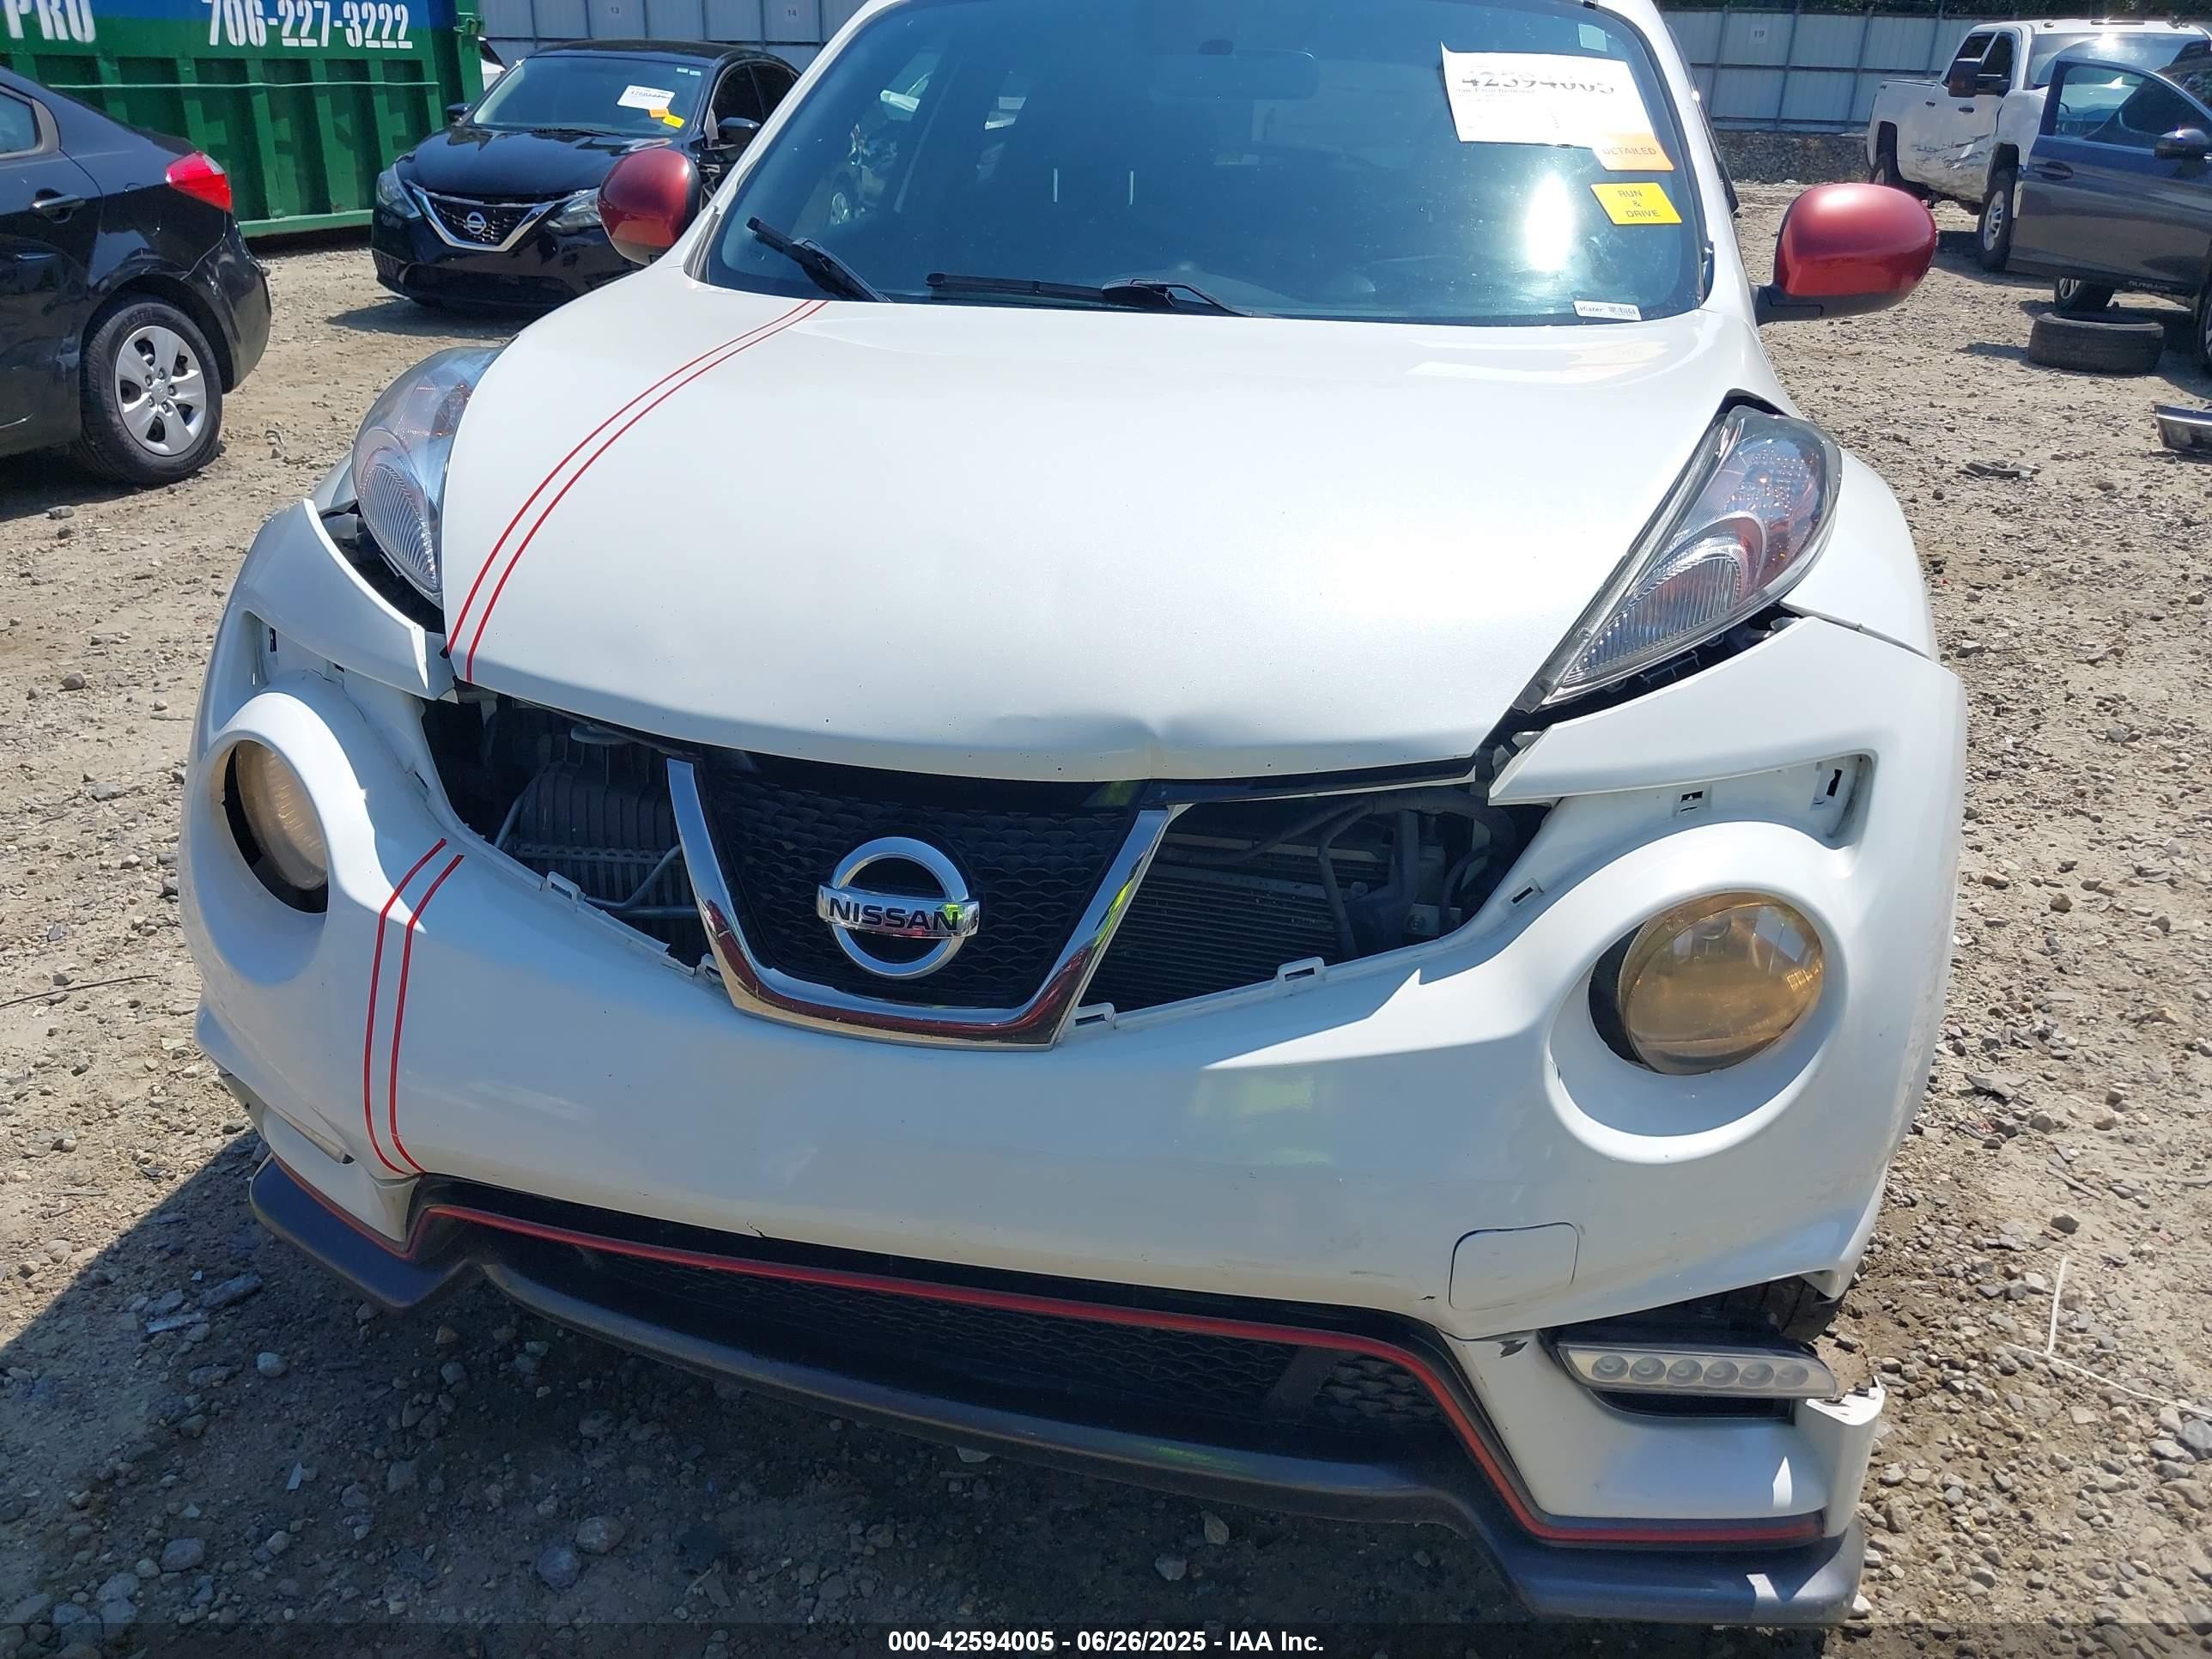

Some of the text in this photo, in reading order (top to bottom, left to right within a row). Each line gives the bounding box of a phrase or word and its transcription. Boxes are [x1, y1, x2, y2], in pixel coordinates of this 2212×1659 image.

[4, 0, 96, 43] PRO
[201, 0, 413, 49] 706-227-3222
[1753, 30, 1765, 39] 19
[1601, 147, 1656, 155] DETAILED
[1626, 210, 1662, 218] DRIVE
[830, 897, 958, 931] NISSAN
